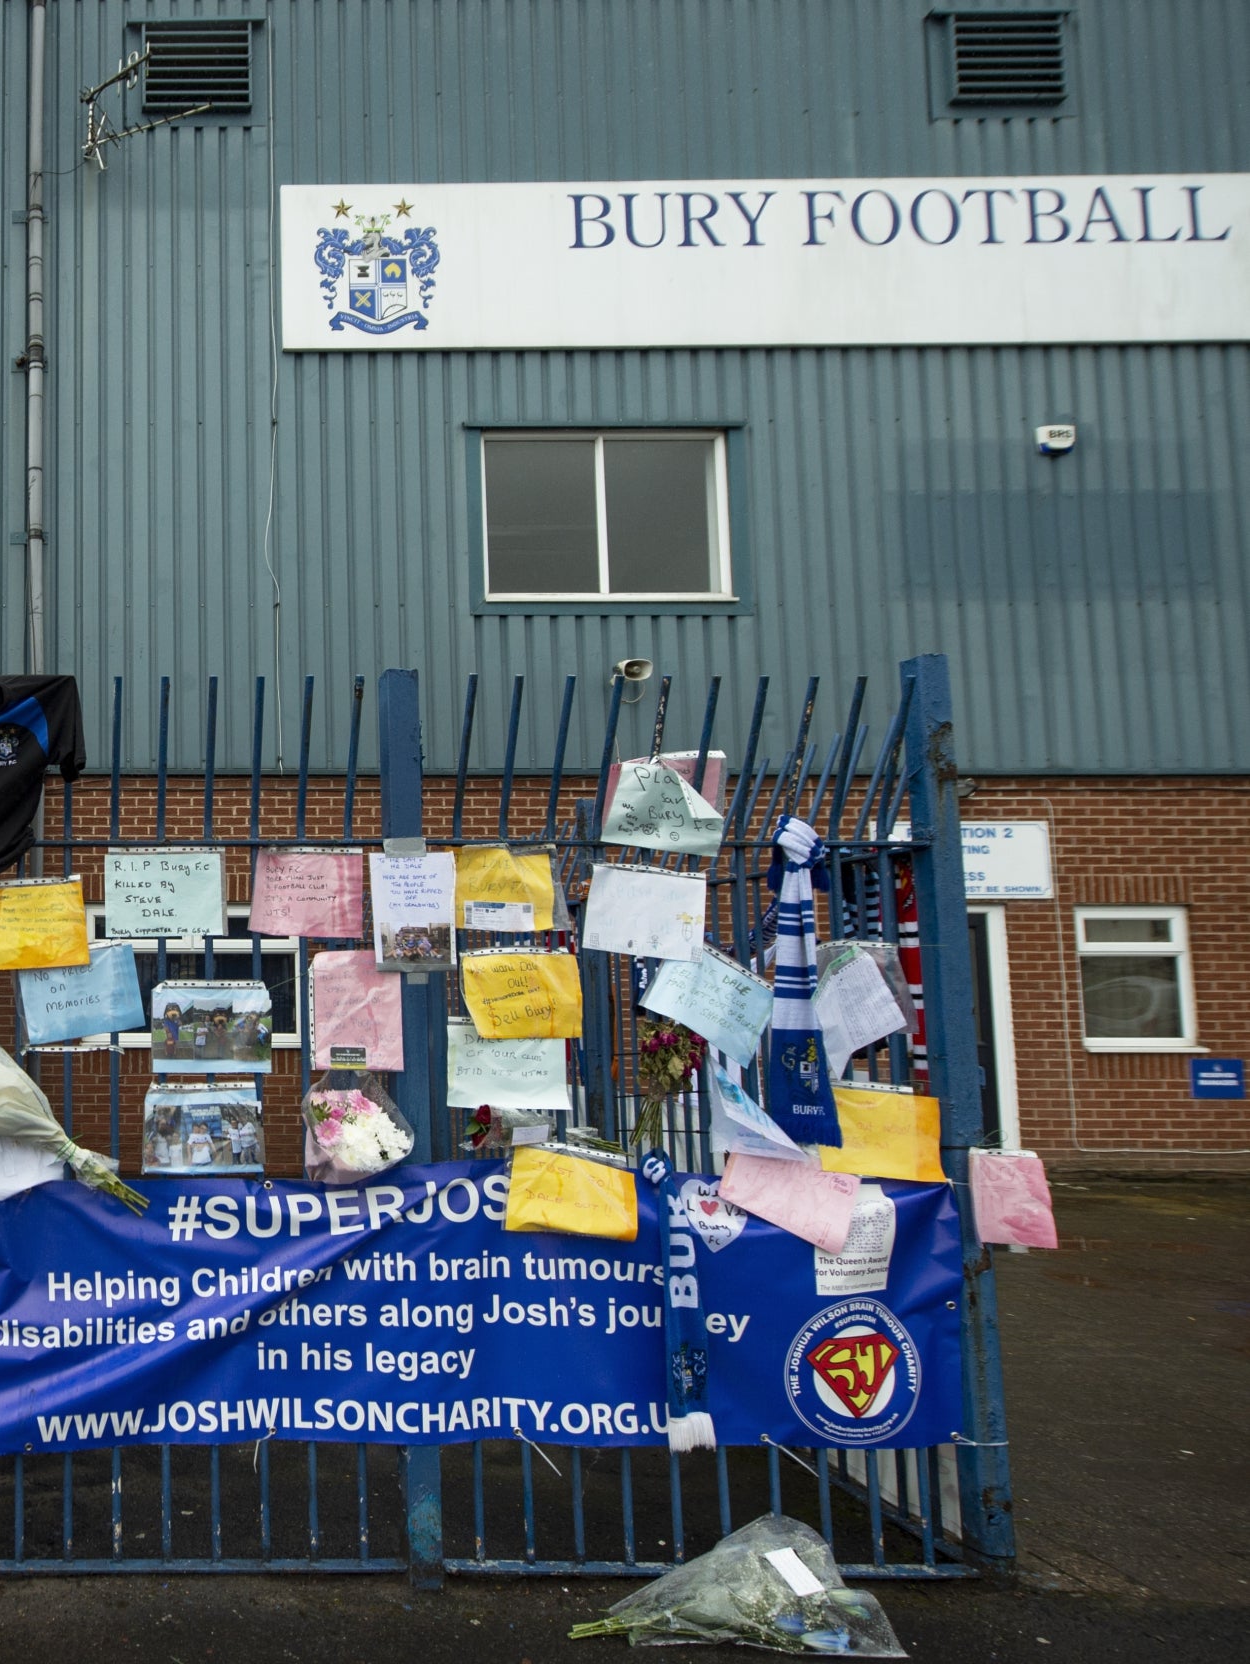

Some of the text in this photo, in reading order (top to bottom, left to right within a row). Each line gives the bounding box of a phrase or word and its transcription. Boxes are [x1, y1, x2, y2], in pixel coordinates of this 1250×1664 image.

[570, 185, 1232, 250] BURY FOOTBALL
[961, 828, 1014, 839] TION 2
[962, 845, 991, 855] TING
[114, 880, 152, 889] KILLED
[964, 885, 981, 893] UST
[124, 895, 162, 904] STEVE
[168, 1175, 510, 1242] #SUPERJOS
[815, 1268, 828, 1276] for
[829, 1267, 866, 1278] Voluntary
[818, 1255, 888, 1266] The Queen's Award
[47, 1250, 665, 1308] Helping Children with brain tumours
[186, 1309, 251, 1341] and
[258, 1298, 368, 1327] others
[379, 1297, 474, 1334] along
[482, 1293, 597, 1327] Josh's
[605, 1297, 751, 1343] jouey
[257, 1341, 476, 1382] in his legacy
[789, 1302, 918, 1397] THE JOSHUA WILSON BRAIN TUMOUR CHARITY
[37, 1396, 670, 1443] WWW.JOSHWILSONCHARITY.ORG.U
